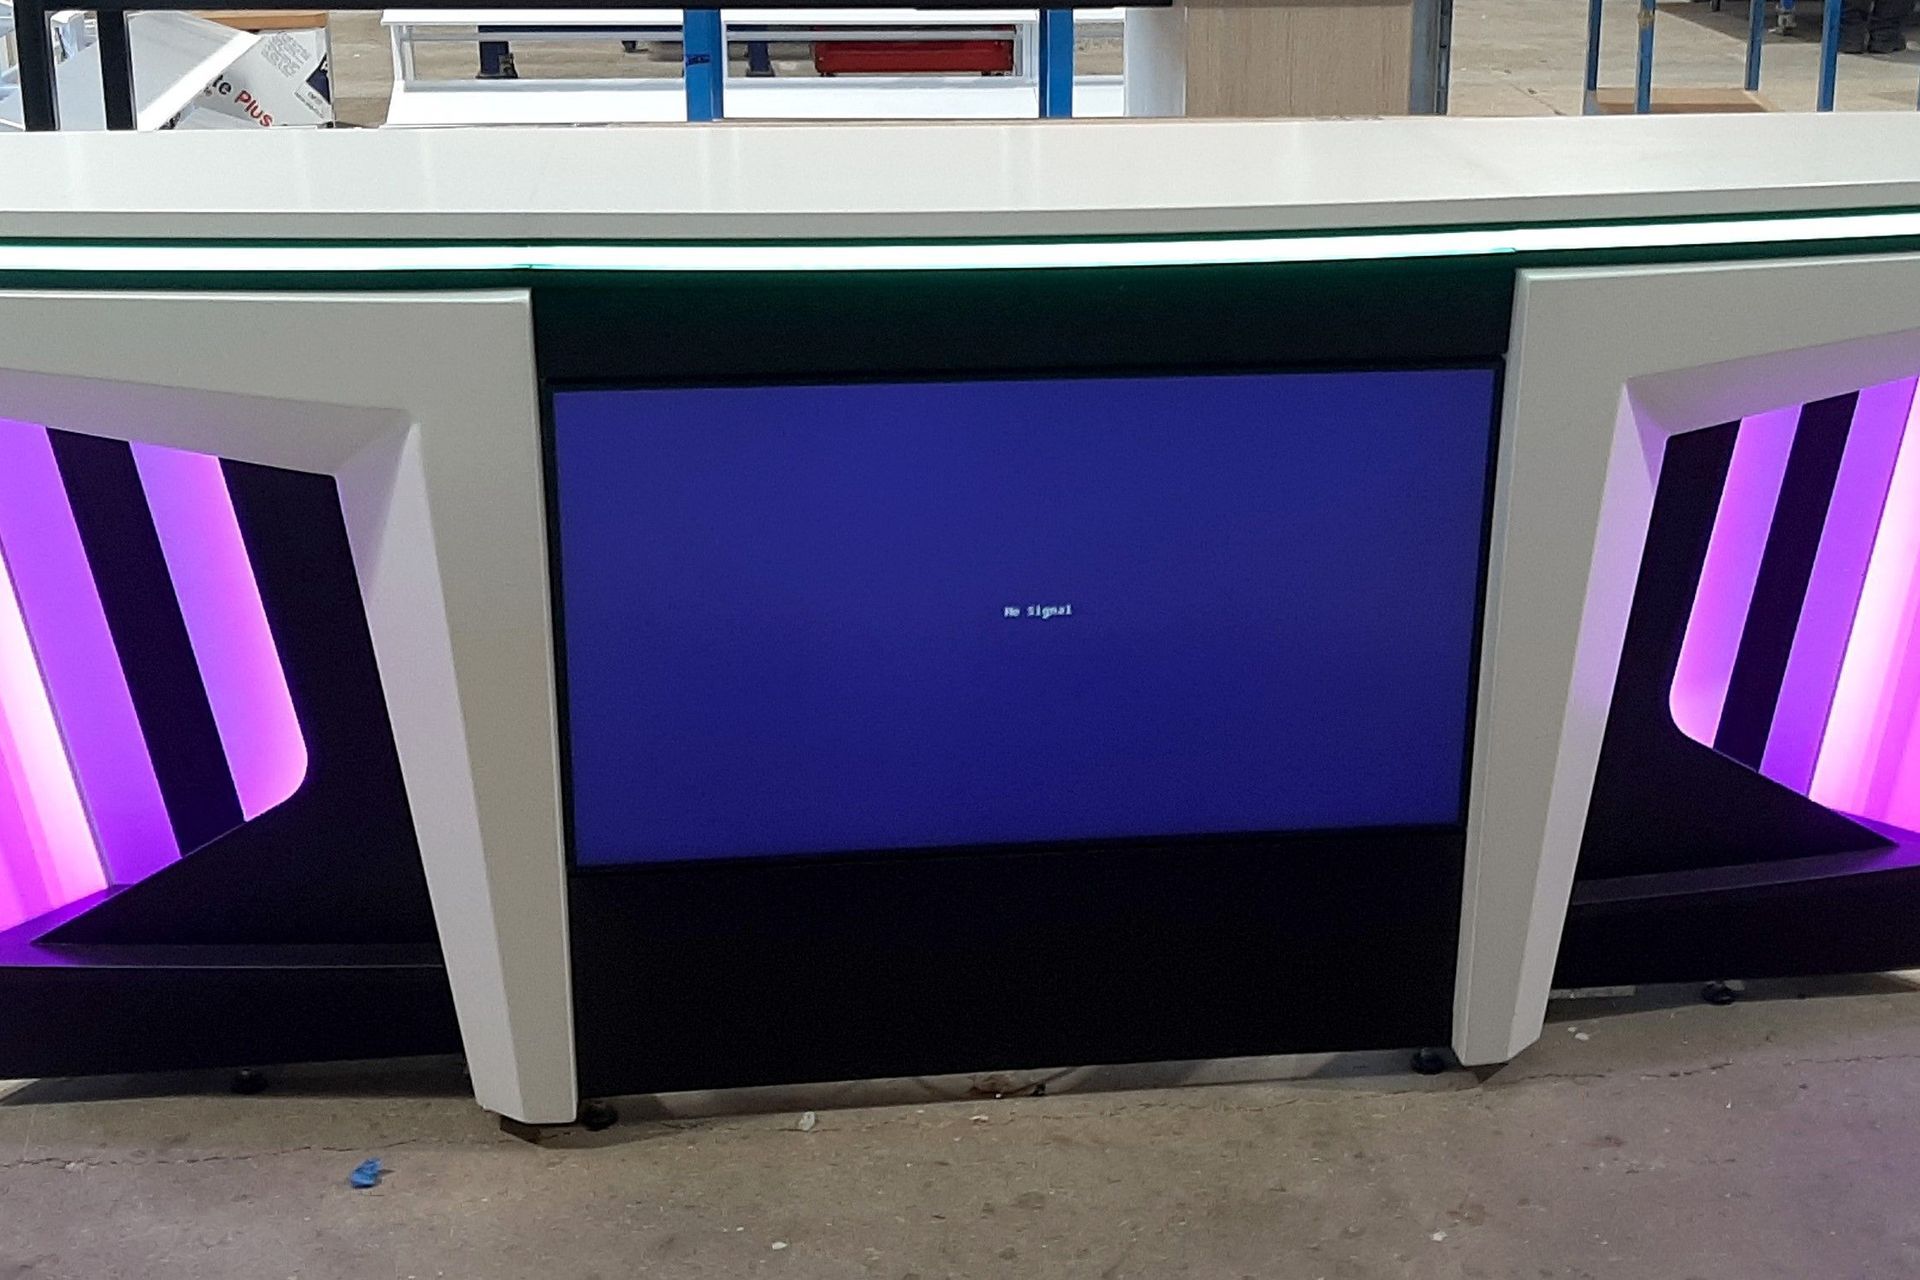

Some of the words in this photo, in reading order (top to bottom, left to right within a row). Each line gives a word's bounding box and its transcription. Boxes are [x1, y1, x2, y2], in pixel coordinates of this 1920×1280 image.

[234, 90, 273, 127] Plus
[1003, 606, 1020, 618] No
[1026, 604, 1072, 620] Signal
